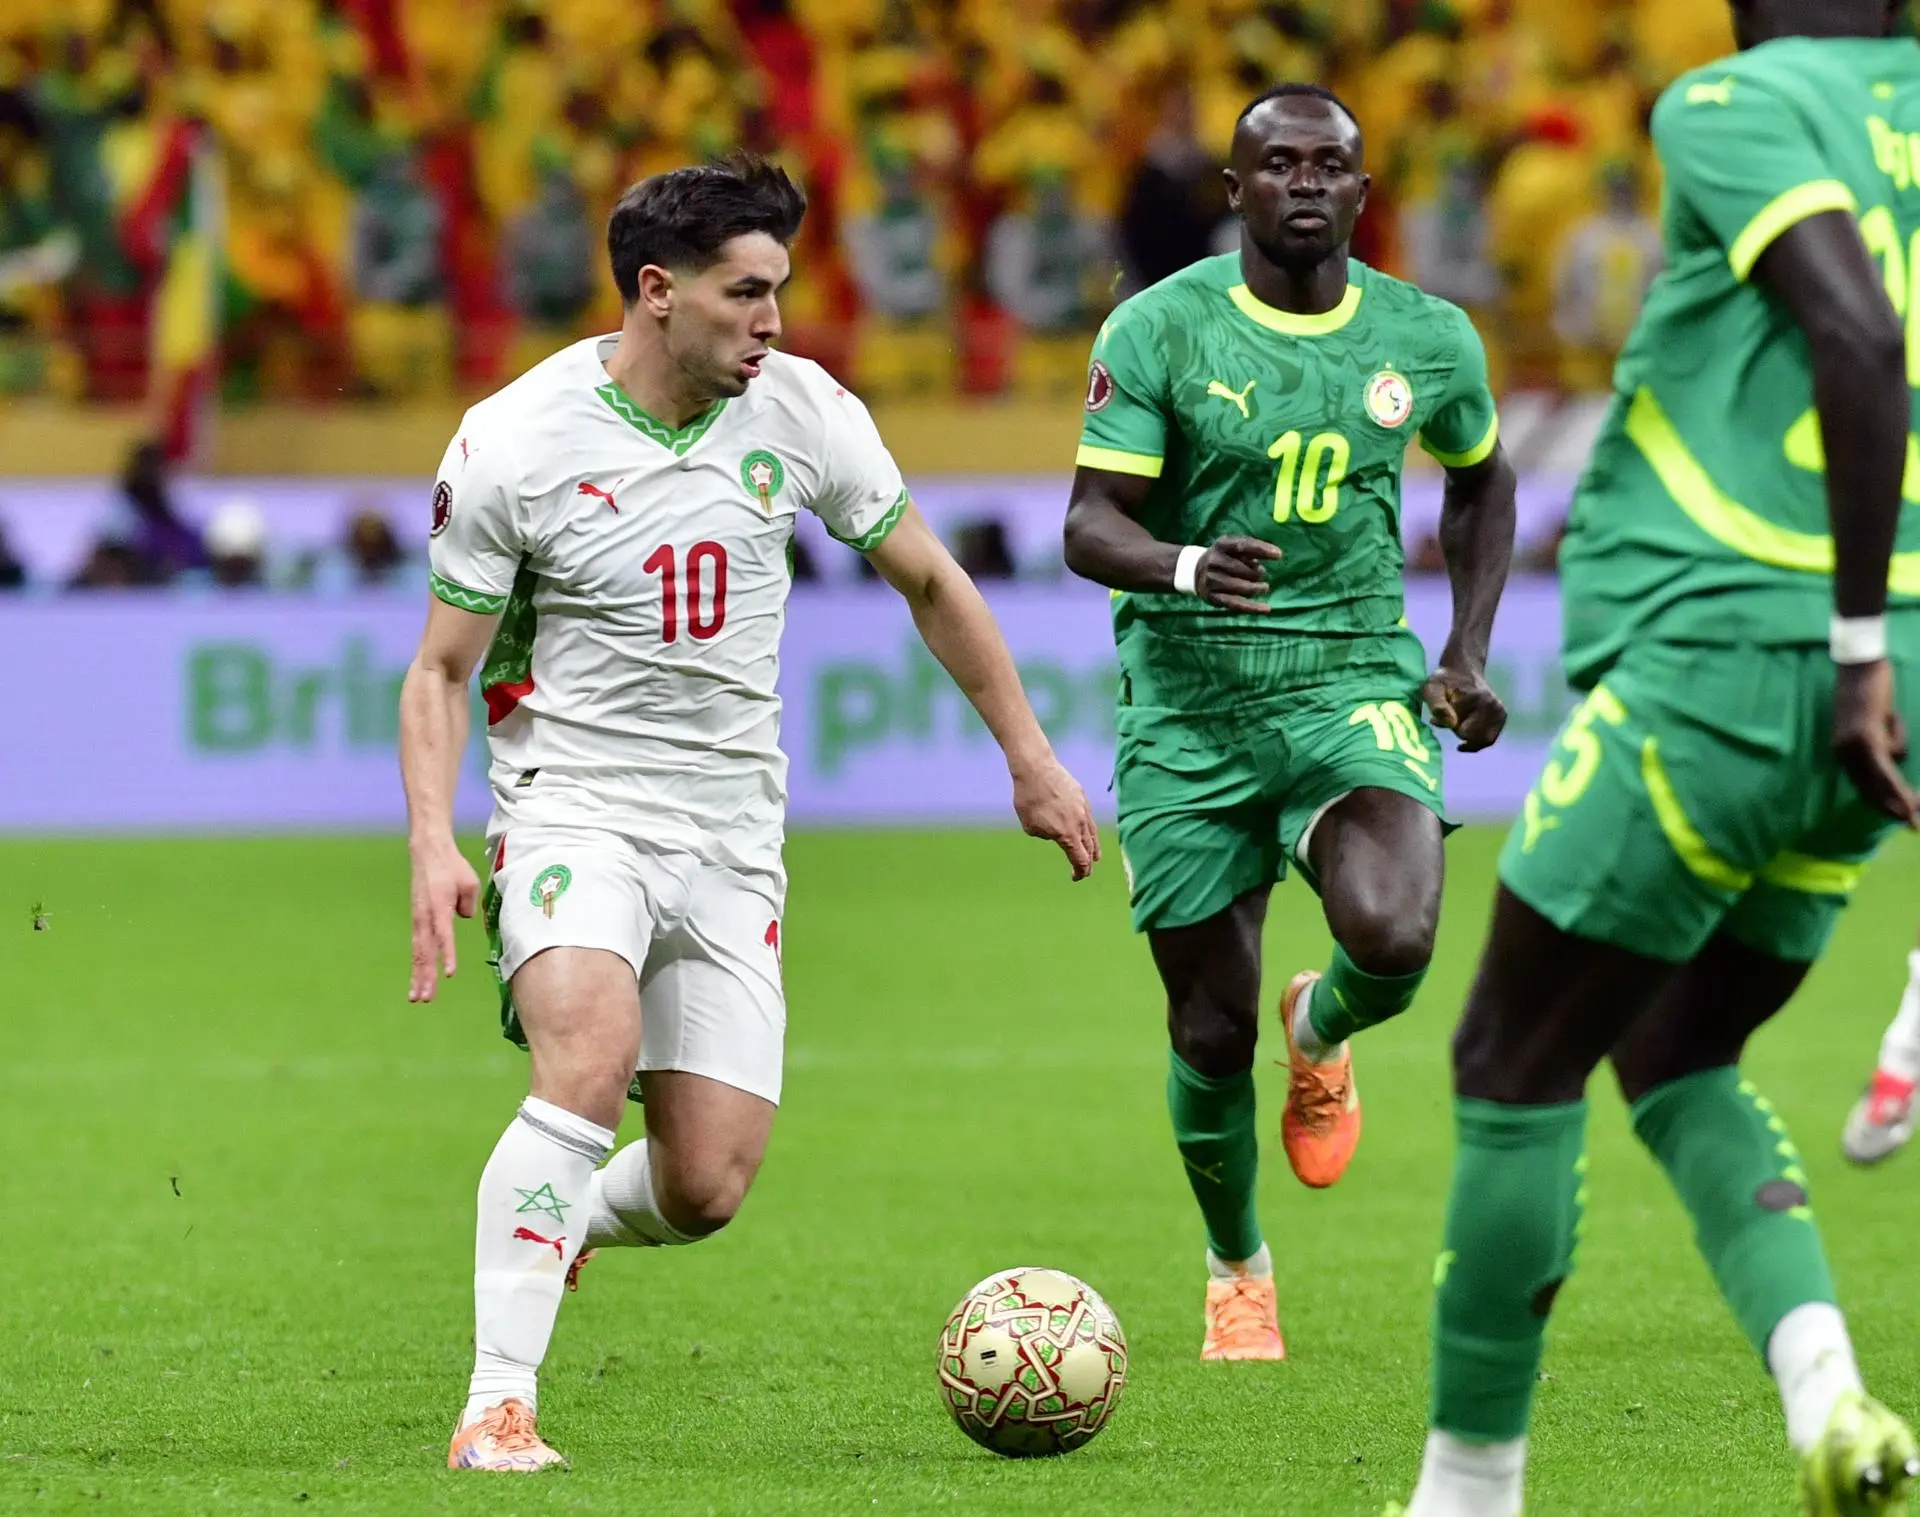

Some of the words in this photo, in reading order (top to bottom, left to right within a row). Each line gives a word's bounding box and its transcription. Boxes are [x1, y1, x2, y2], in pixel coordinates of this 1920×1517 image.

[1267, 430, 1351, 524] 10
[643, 541, 727, 643] 10
[1348, 700, 1431, 764] 10
[1541, 683, 1628, 807] 5
